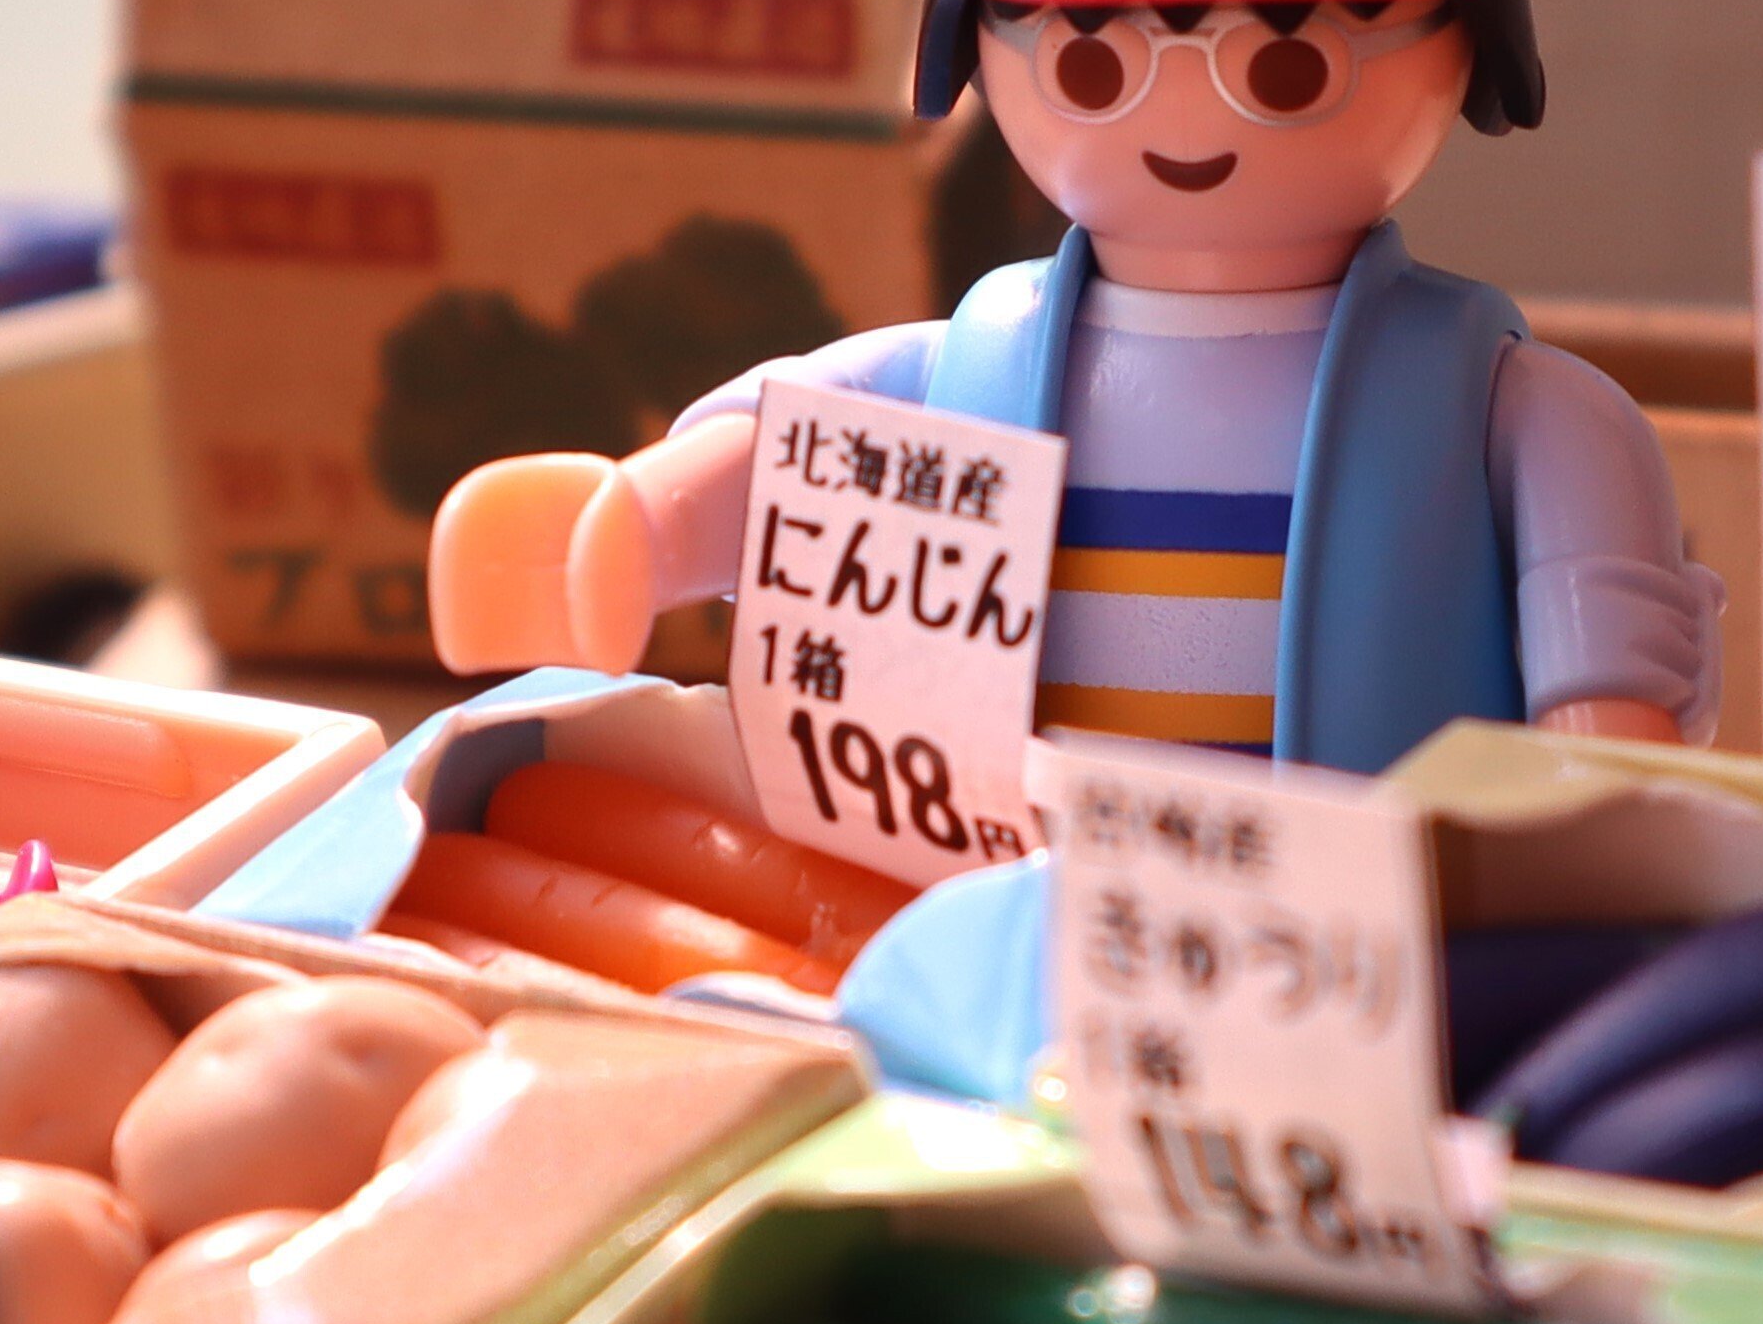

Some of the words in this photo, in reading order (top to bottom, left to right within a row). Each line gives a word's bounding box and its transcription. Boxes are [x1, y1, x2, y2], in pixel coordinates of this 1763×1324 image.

[774, 420, 1003, 525] 北海道産
[757, 504, 1035, 649] にんじん
